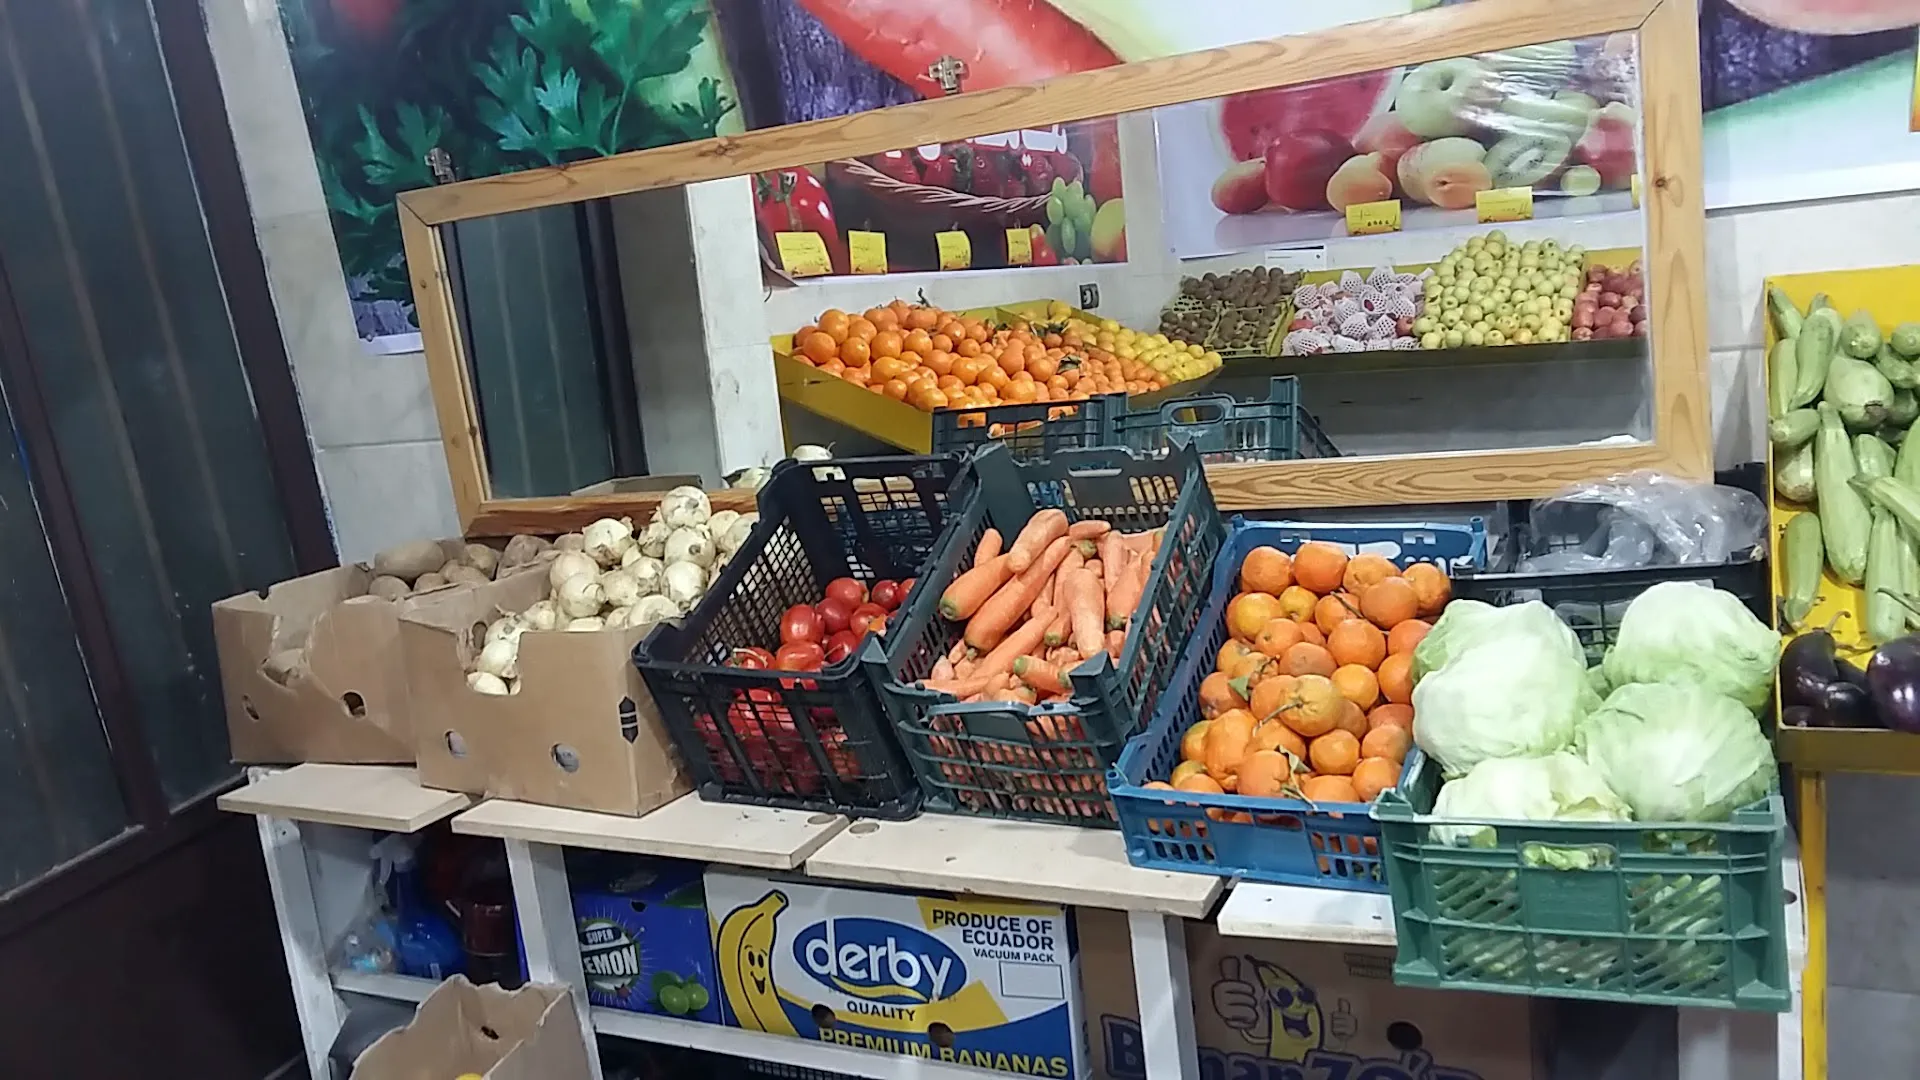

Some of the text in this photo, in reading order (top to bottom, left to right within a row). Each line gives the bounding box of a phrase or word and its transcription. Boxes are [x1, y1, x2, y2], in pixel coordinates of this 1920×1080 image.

[932, 909, 1053, 935] PRODUCE OF
[586, 929, 614, 943] SUPER
[962, 929, 1054, 951] ECUADOR
[584, 945, 639, 976] EMON
[806, 918, 952, 1004] derby
[973, 948, 1055, 963] VACUUM PACK
[847, 1000, 916, 1022] QUALITY
[819, 1027, 1069, 1078] PREMIUM BANANAS
